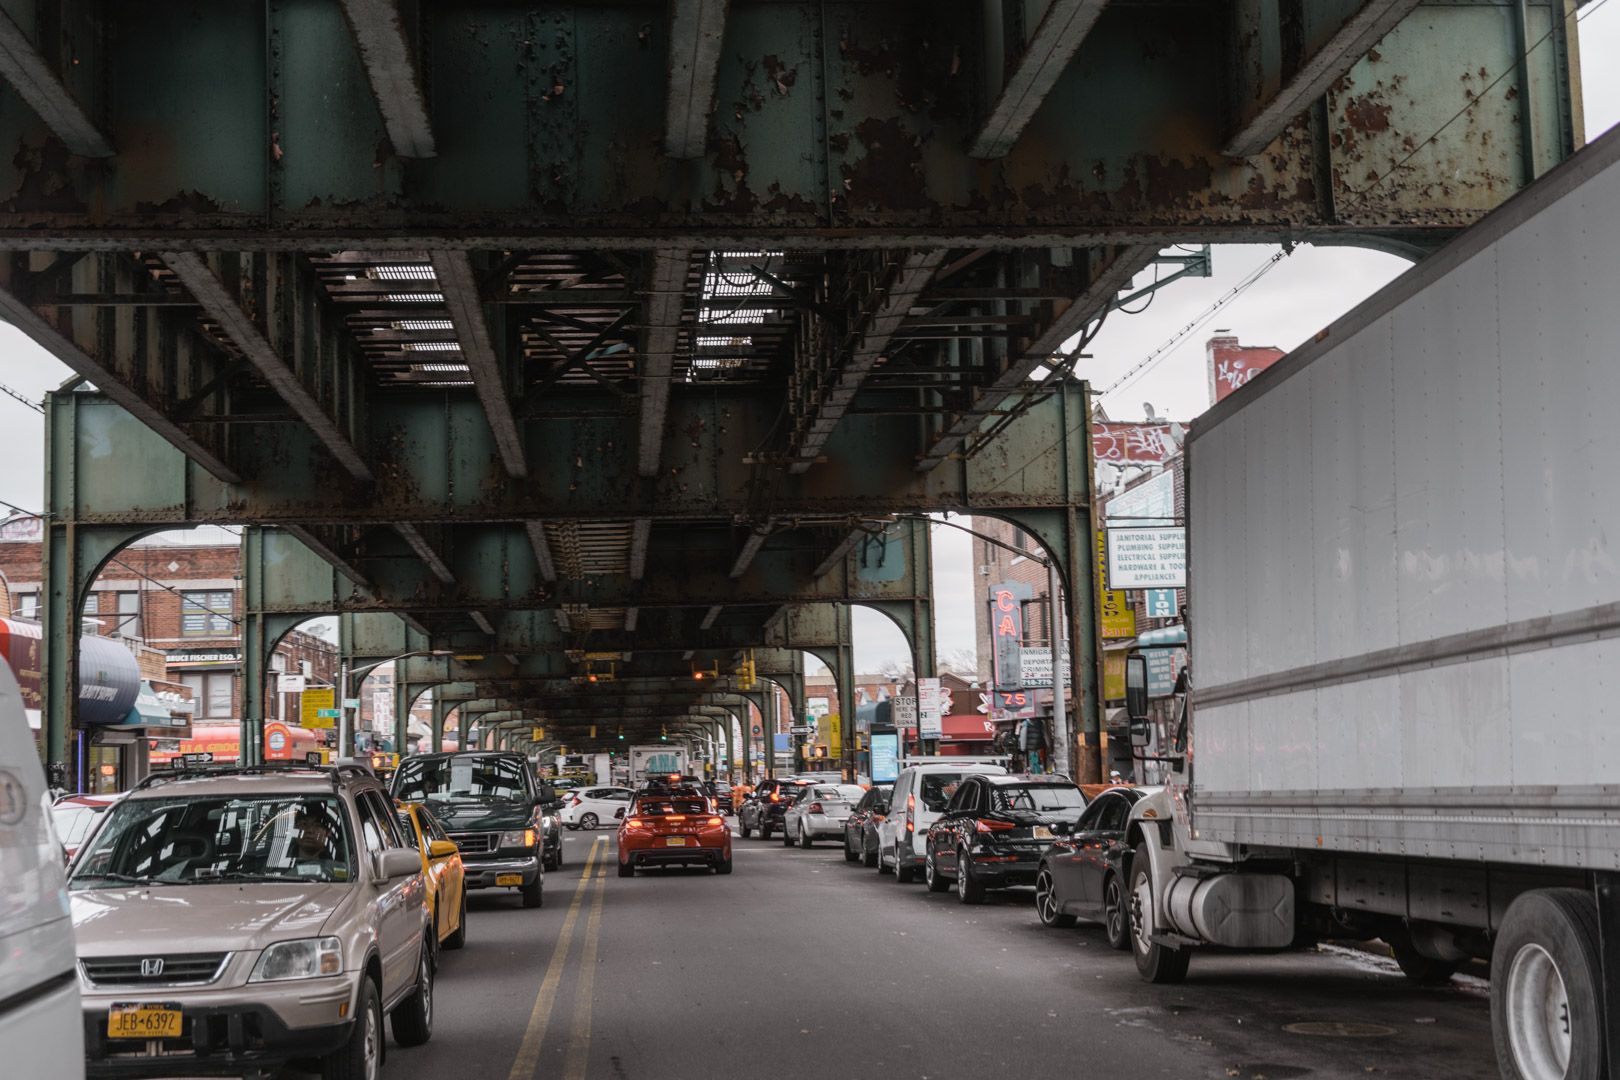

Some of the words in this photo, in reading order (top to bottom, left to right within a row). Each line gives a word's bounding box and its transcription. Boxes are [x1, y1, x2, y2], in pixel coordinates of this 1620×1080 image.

[1117, 543, 1154, 551] PLUMBING
[1117, 553, 1156, 561] ELECTRICAL
[1118, 563, 1157, 571] HARDWARE
[1134, 573, 1176, 581] APPLIANCES
[1154, 588, 1170, 616] ION
[190, 654, 219, 662] FISCHER
